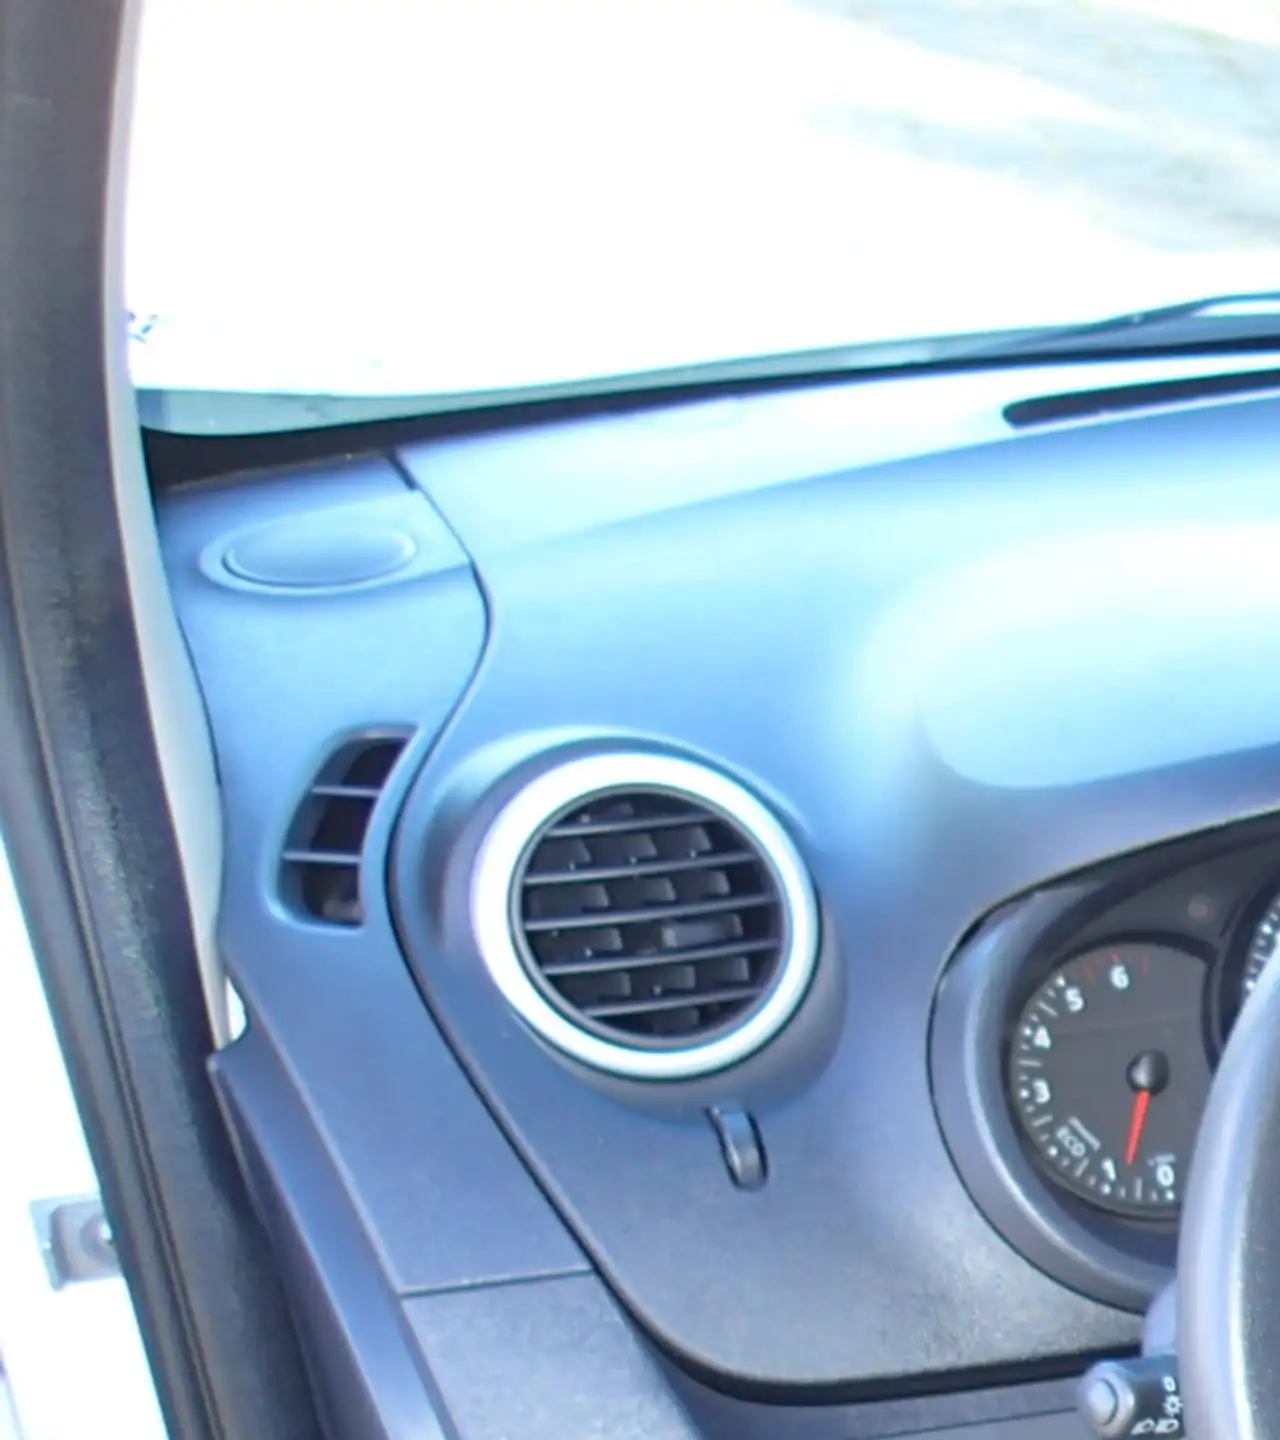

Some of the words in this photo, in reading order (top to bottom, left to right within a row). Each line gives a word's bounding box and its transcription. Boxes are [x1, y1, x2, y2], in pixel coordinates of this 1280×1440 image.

[1110, 965, 1129, 989] 6
[1065, 986, 1085, 1013] 5
[1033, 1024, 1051, 1050] 4
[1033, 1077, 1051, 1104] 3
[1056, 1126, 1086, 1156] ECO
[1101, 1158, 1117, 1182] 1
[1156, 1164, 1175, 1187] 0
